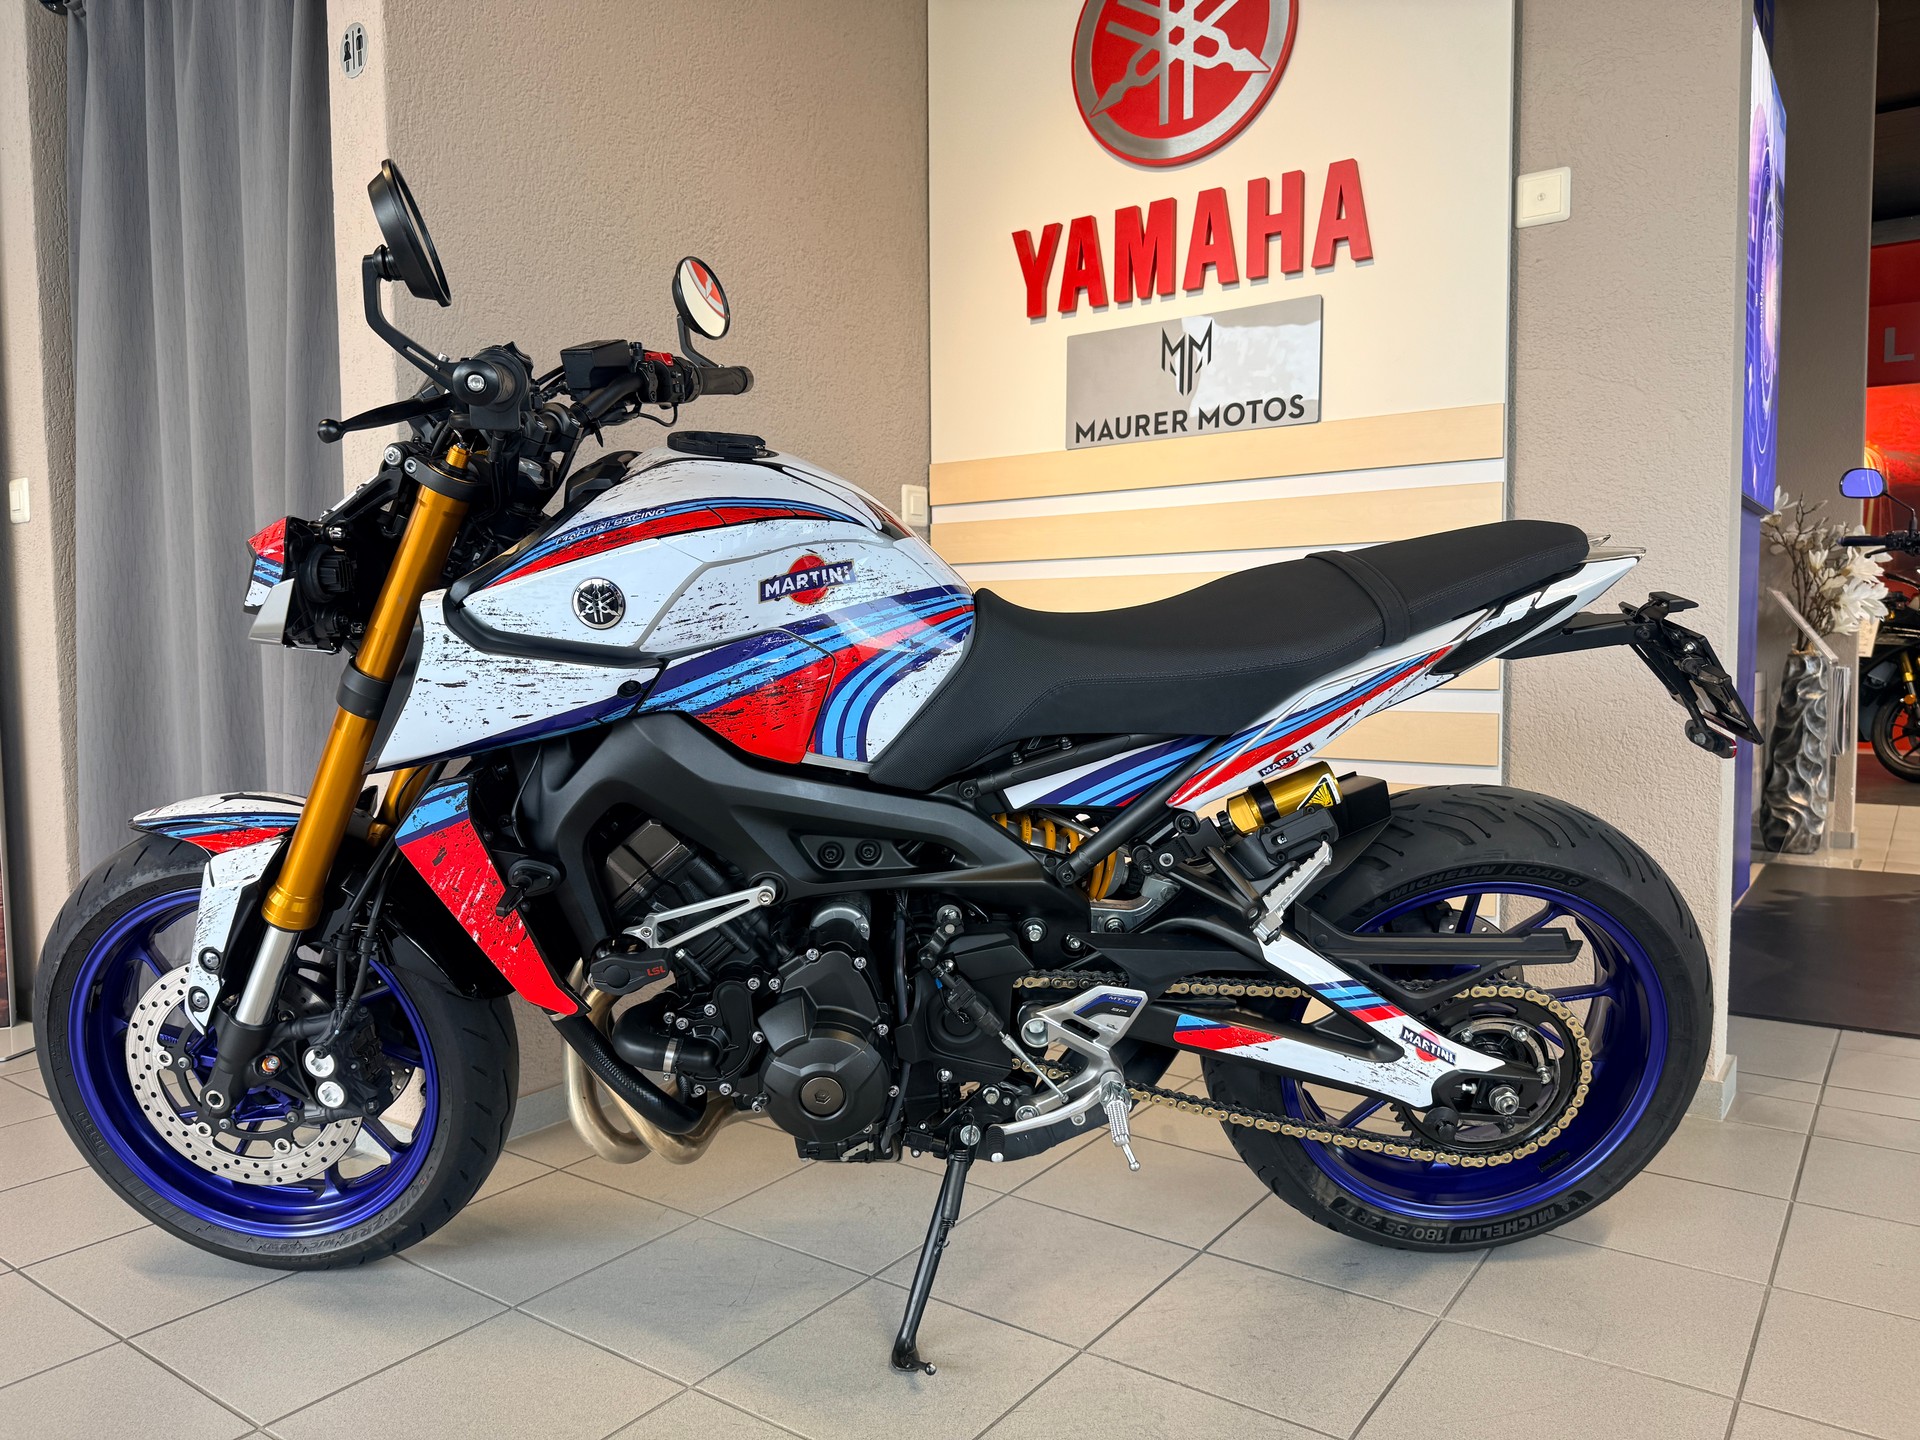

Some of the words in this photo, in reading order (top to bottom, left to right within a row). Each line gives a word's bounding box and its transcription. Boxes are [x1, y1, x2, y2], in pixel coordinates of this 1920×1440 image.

[1012, 158, 1373, 319] YAMAHA
[1075, 409, 1189, 444] MAURER
[1198, 394, 1305, 430] MOTOS
[764, 565, 851, 598] MARTINI
[1261, 745, 1311, 775] MARTINI
[1388, 865, 1497, 901] MICHELIN
[1512, 865, 1566, 880] ROAD
[646, 965, 666, 977] LSL
[1402, 1028, 1457, 1064] MARTINI
[1383, 1222, 1445, 1241] 180/55
[1459, 1208, 1557, 1242] MICHELIN
